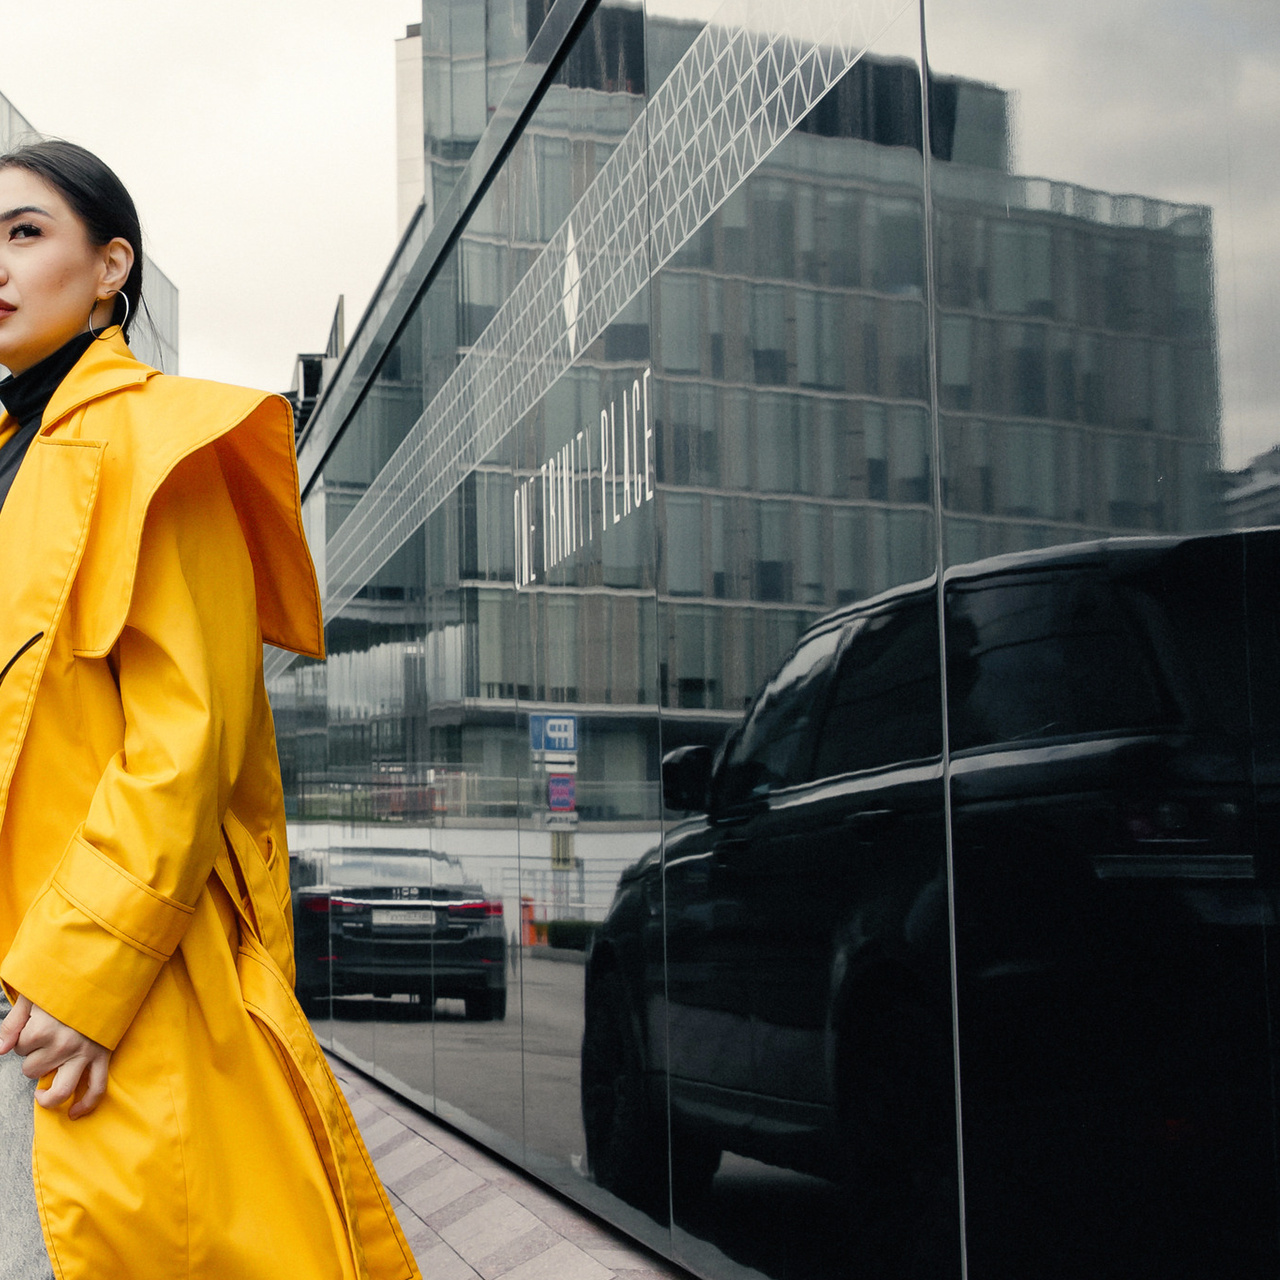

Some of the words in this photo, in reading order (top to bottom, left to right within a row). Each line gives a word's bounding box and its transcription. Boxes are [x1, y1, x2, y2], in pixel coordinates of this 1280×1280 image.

[513, 476, 536, 591] ONE
[540, 424, 593, 572] TRINITY
[600, 367, 654, 531] PLACE
